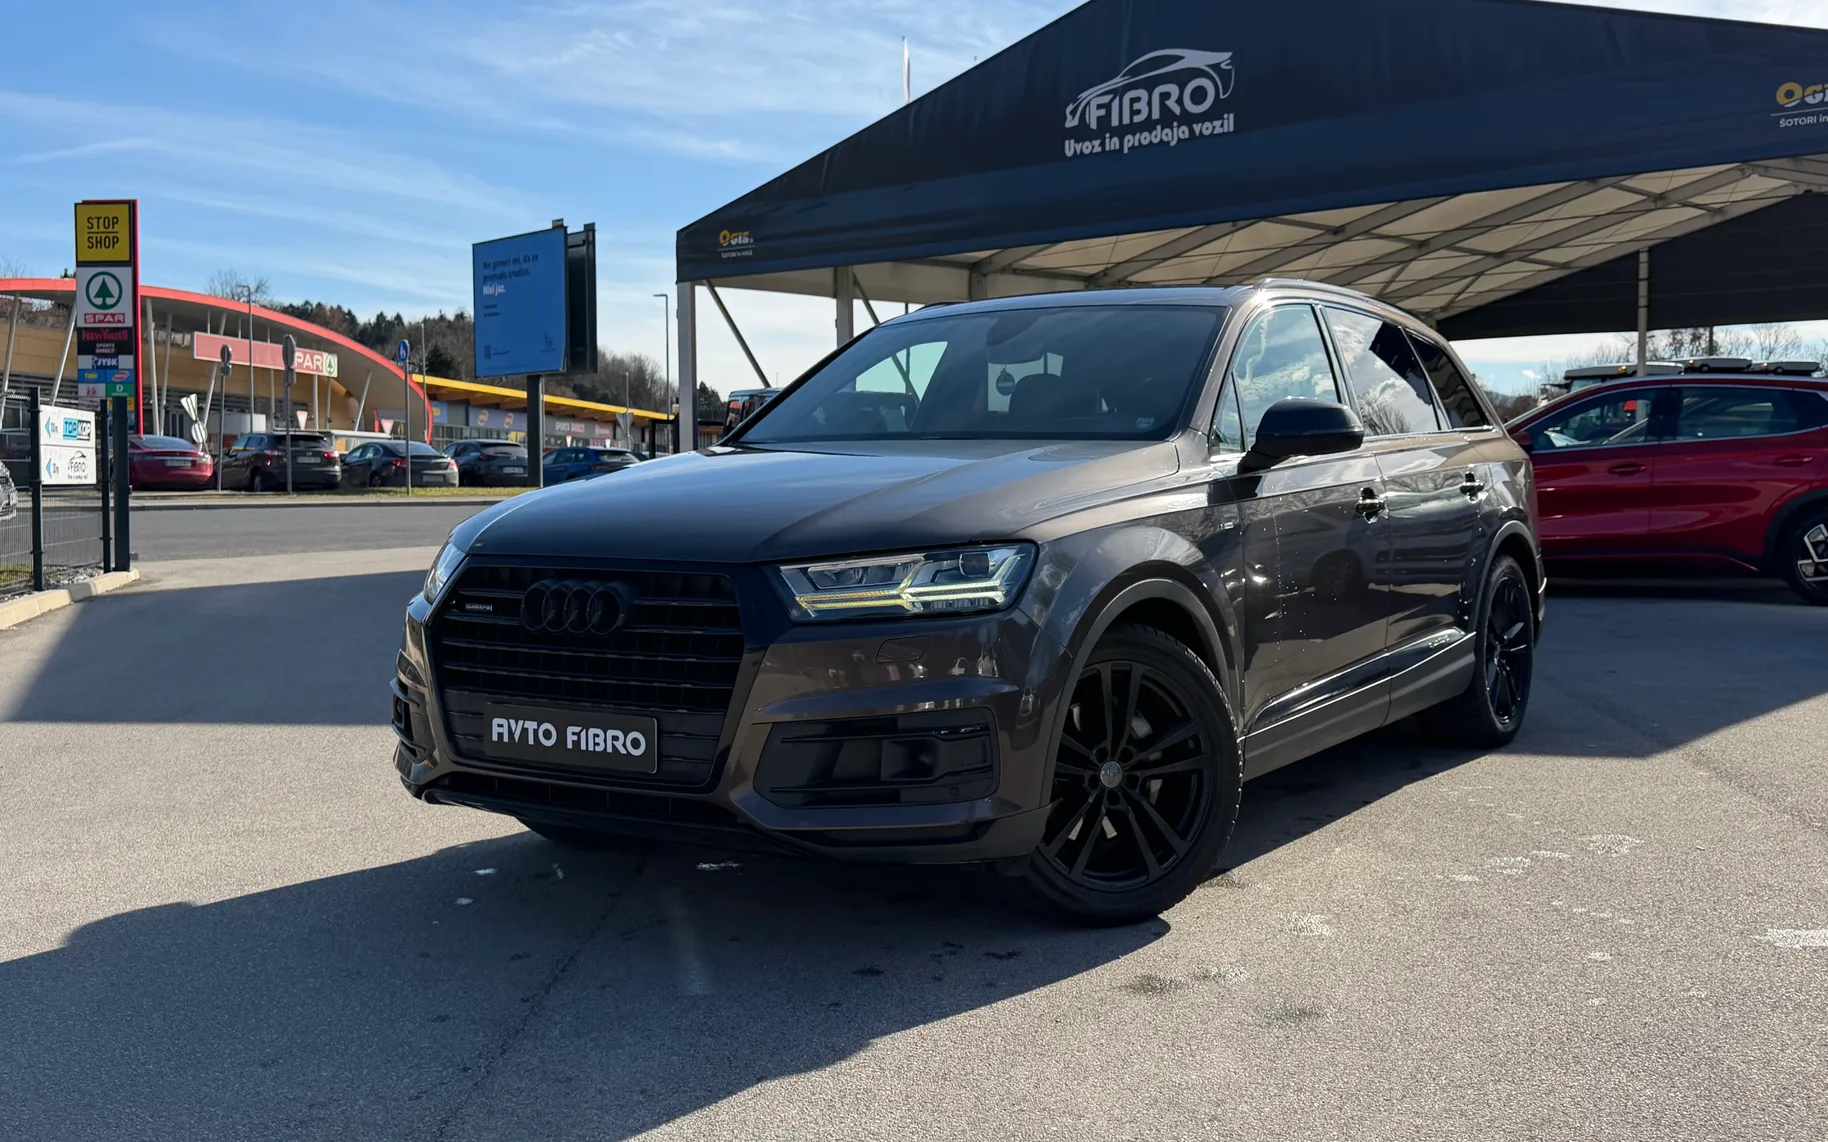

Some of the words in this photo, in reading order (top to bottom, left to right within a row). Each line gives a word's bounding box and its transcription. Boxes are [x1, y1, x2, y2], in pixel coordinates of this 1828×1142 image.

[1085, 77, 1216, 130] FIBRO
[1064, 140, 1102, 157] Uvoz
[1105, 133, 1119, 151] in
[1123, 121, 1189, 154] prodaja
[1192, 113, 1234, 137] vozil
[87, 216, 119, 230] STOP
[87, 236, 120, 250] SHOP
[85, 314, 124, 323] SPAR
[97, 358, 118, 366] JYSK
[294, 351, 323, 370] PAR
[64, 421, 77, 434] TOP
[491, 717, 558, 747] AVTO
[566, 725, 647, 757] FIBRO
